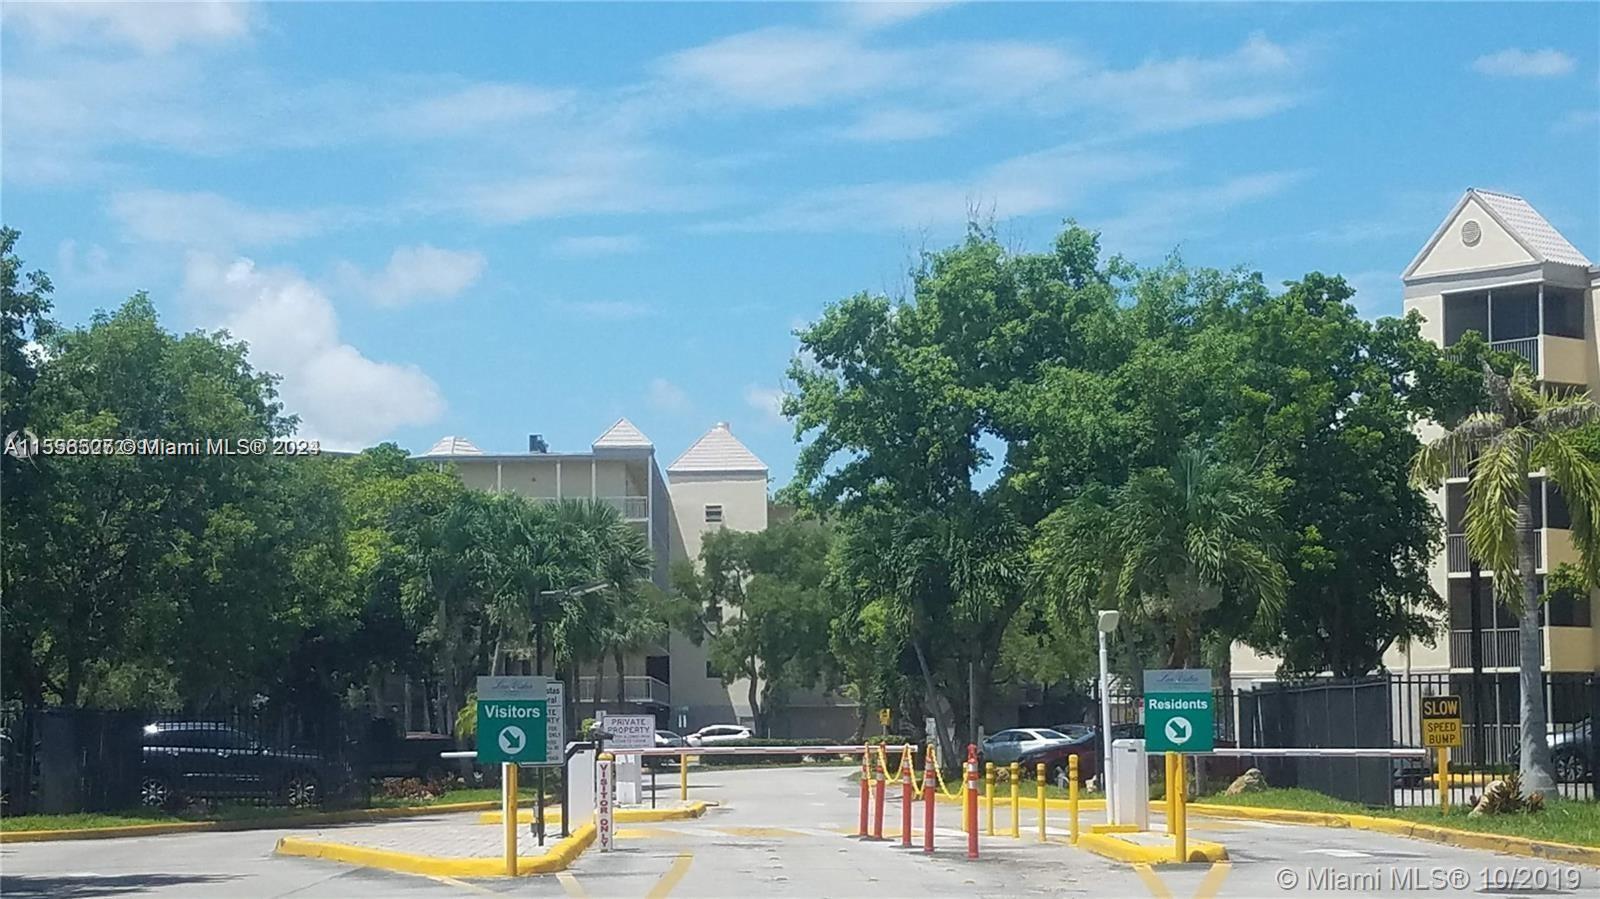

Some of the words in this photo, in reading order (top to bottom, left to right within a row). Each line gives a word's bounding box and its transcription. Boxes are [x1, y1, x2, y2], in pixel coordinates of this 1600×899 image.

[1149, 699, 1208, 710] Residents
[1423, 700, 1458, 716] SLOW
[484, 704, 541, 718] Visitors
[611, 718, 646, 726] PRIVATE
[1427, 722, 1457, 733] SPEED
[607, 726, 650, 734] PROPERTY
[1428, 734, 1456, 744] BUMP
[600, 764, 609, 814] VISITOR
[600, 818, 609, 847] ONLY
